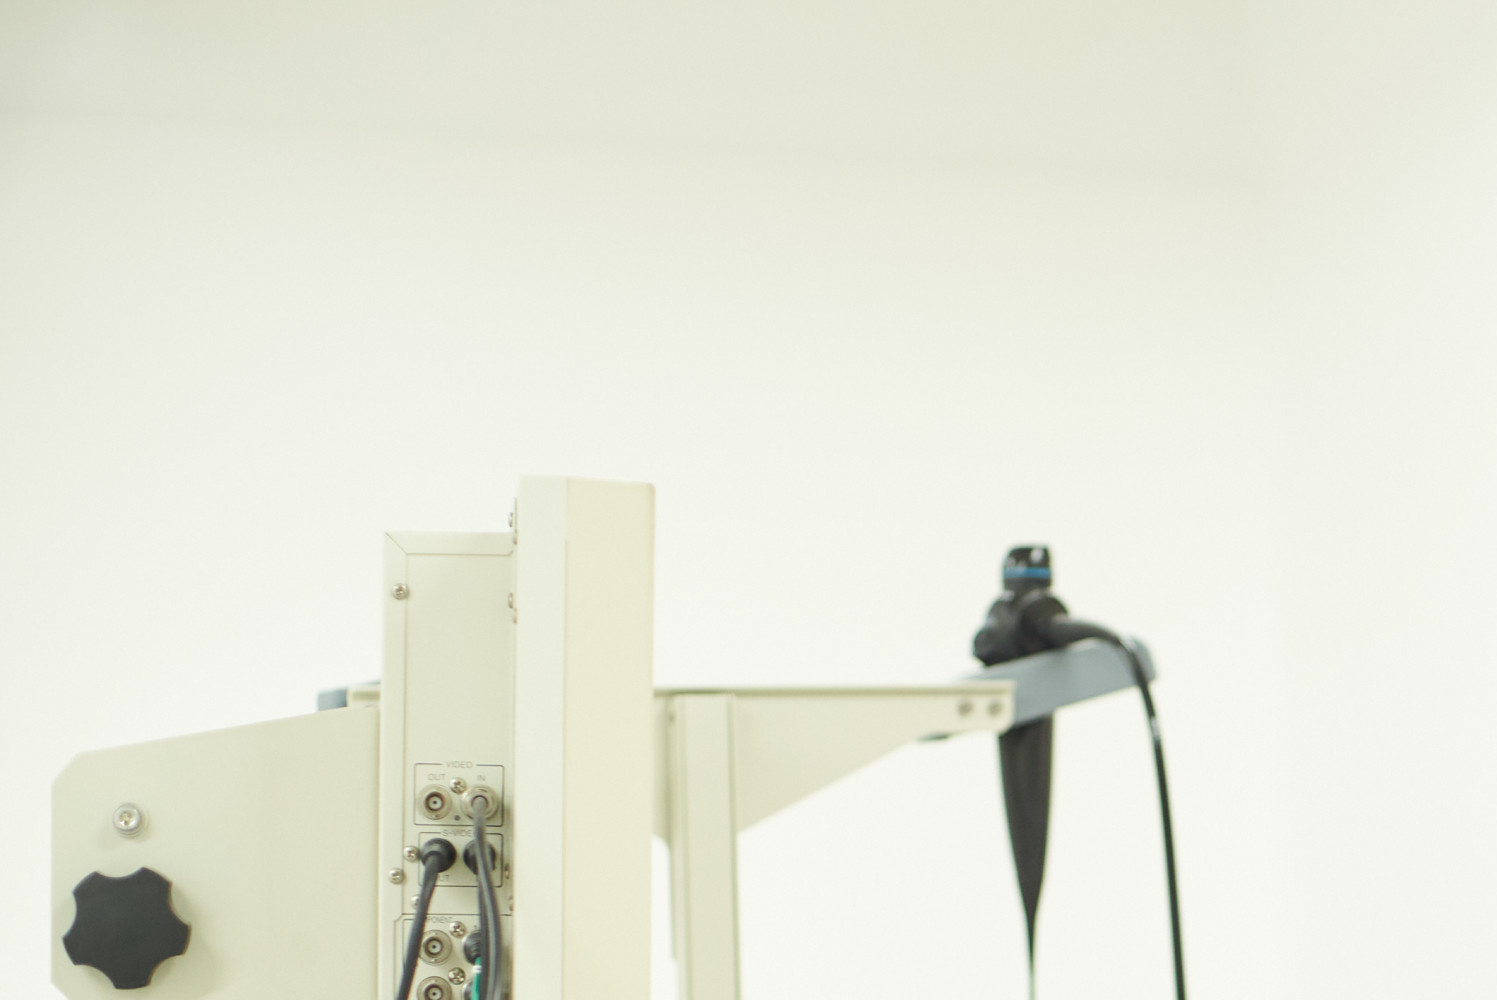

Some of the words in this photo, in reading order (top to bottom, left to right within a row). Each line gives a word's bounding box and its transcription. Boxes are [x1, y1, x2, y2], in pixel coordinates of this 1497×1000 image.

[446, 760, 474, 769] VIDEO
[427, 773, 447, 781] OUT
[476, 774, 487, 782] IN
[441, 829, 473, 837] S-VIDE
[438, 874, 450, 882] UT
